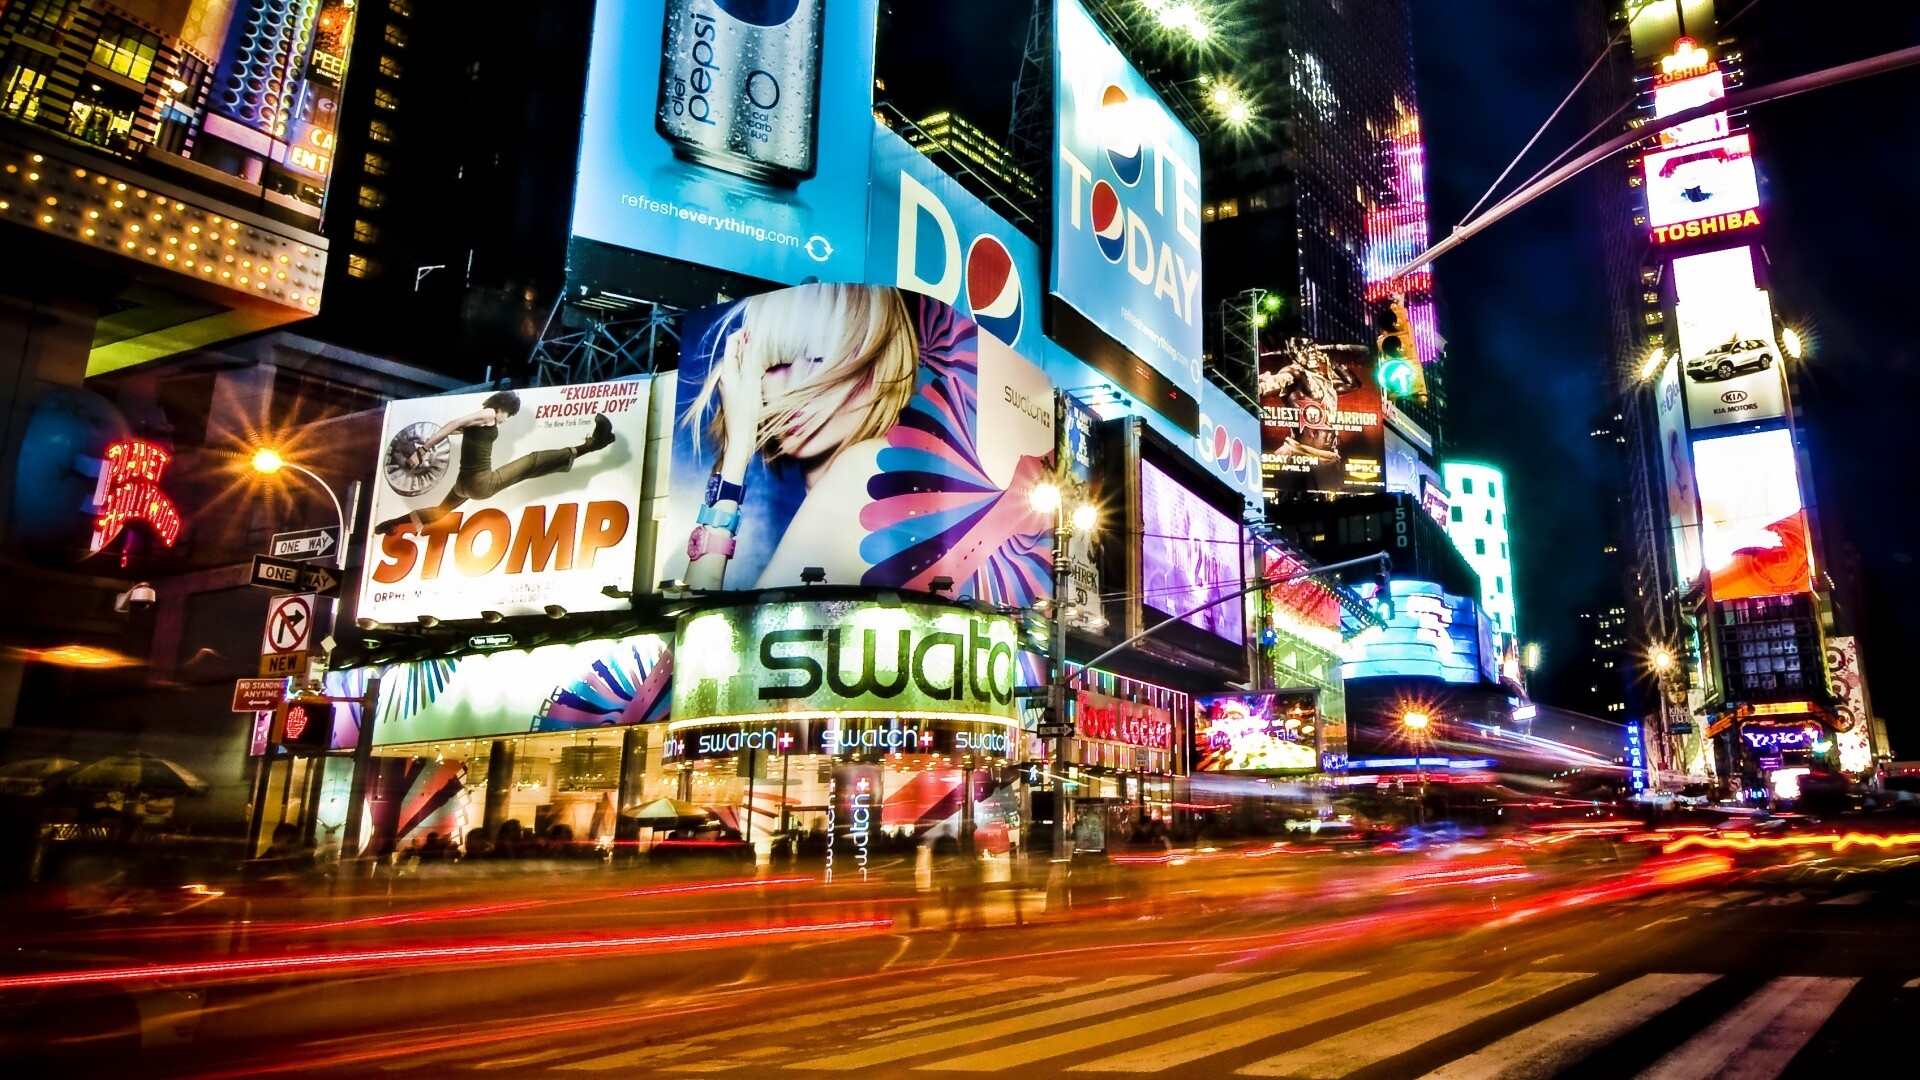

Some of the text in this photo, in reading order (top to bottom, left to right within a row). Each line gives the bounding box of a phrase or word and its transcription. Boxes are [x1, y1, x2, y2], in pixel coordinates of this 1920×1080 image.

[688, 12, 720, 126] pepsi
[672, 74, 685, 116] diet
[752, 112, 769, 122] cal
[748, 120, 772, 132] carb
[750, 130, 768, 142] sug
[621, 193, 799, 248] refresheverything.com
[1654, 209, 1760, 243] TOSHIBA
[535, 401, 599, 419] EXPLOSIVE
[1713, 402, 1758, 415] KIA MOTORS
[578, 418, 591, 426] Times
[1325, 409, 1378, 426] WARRIOR
[1281, 464, 1301, 472] APRIL
[1291, 455, 1319, 466] 10PM
[1345, 463, 1381, 473] SPIKE
[1395, 494, 1408, 547] 1500
[280, 537, 329, 553] ONE WAY
[371, 500, 630, 584] STOMP
[265, 566, 293, 582] ONE
[1075, 586, 1088, 606] 3D
[268, 655, 298, 673] NEW
[240, 681, 285, 690] NO STANDING
[243, 690, 279, 698] ANYTIME
[1668, 706, 1690, 716] KING
[699, 727, 776, 754] swatch
[820, 725, 917, 751] swatch
[955, 730, 1010, 752] swatch
